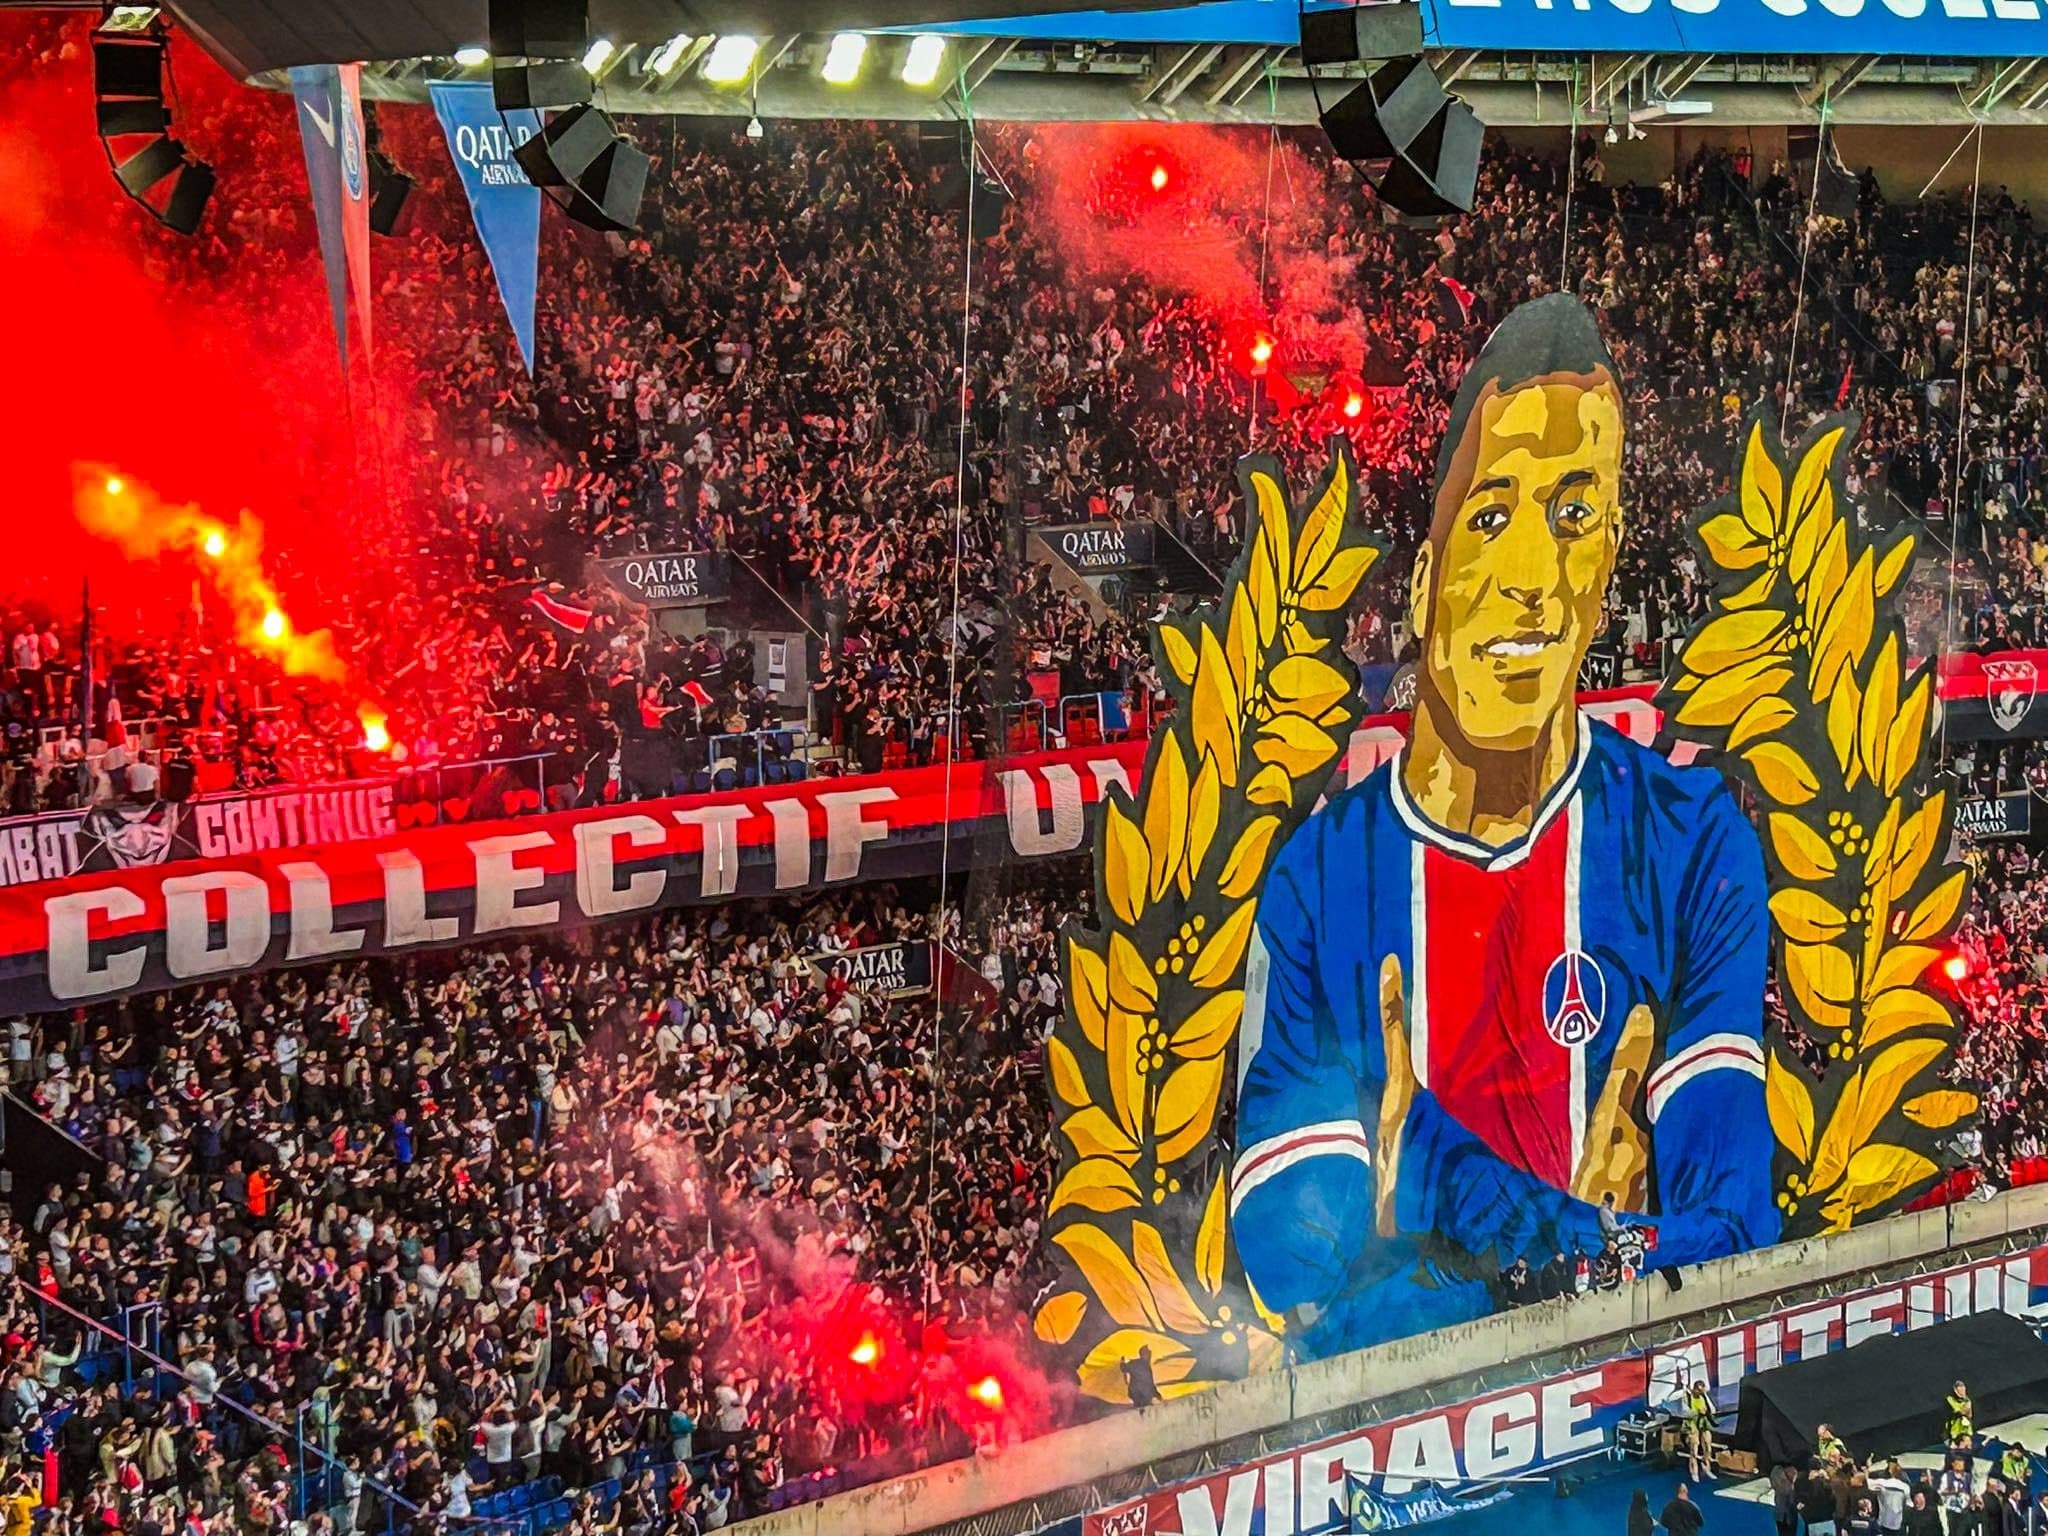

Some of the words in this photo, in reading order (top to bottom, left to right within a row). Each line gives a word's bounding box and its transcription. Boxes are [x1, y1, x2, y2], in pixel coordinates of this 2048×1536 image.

[1062, 530, 1125, 557] QATAR
[625, 558, 698, 590] QATAR
[645, 582, 698, 598] AIRWAYS
[194, 785, 397, 859] CONTINUE
[45, 786, 899, 1000] COLLECTIF
[1176, 1370, 1605, 1536] VIRAGE
